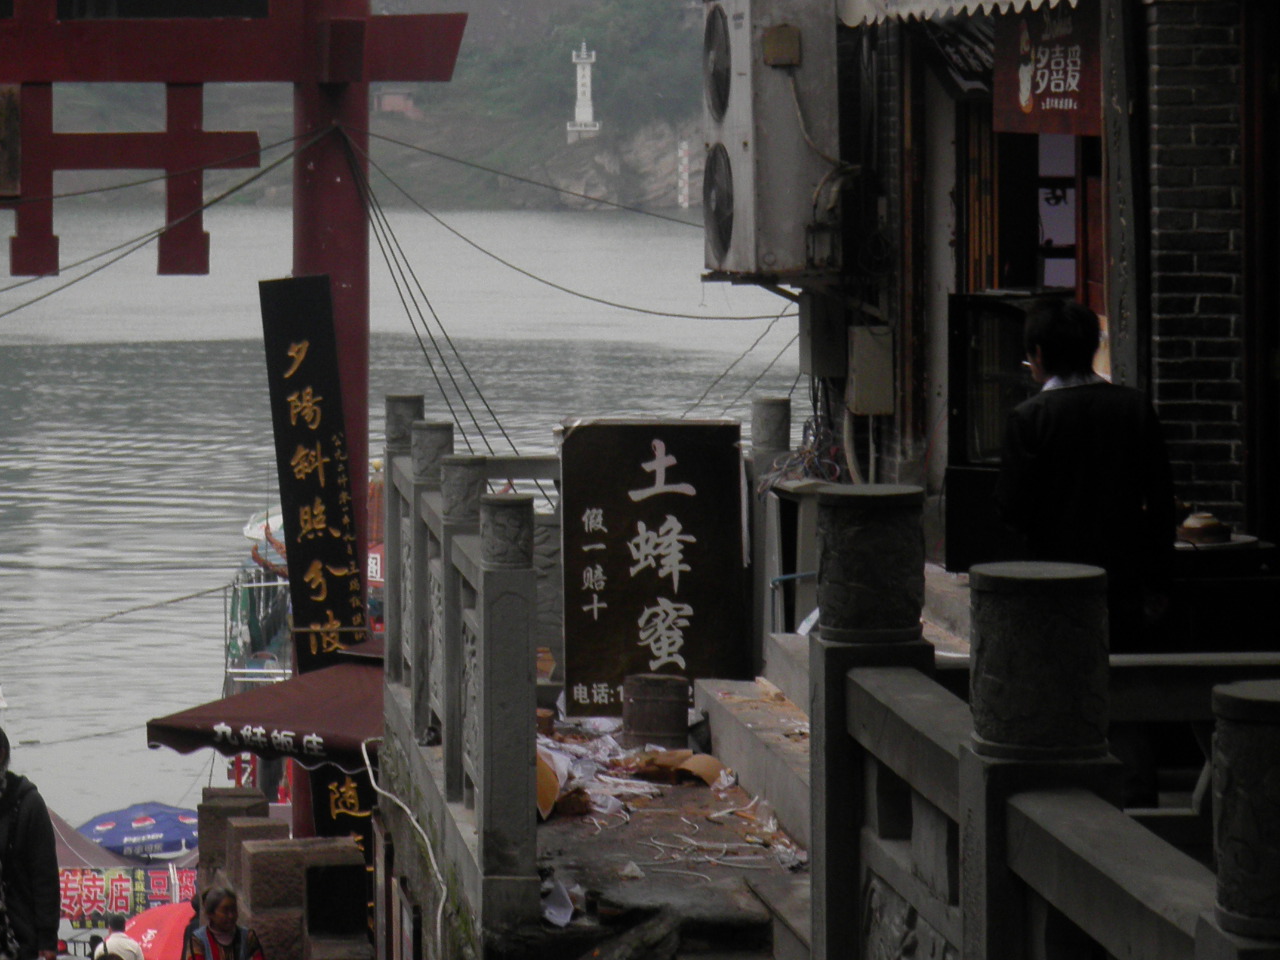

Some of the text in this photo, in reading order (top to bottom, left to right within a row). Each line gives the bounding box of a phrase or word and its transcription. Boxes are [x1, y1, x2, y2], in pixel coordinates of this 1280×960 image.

[581, 507, 608, 622] 假一赔十
[627, 438, 697, 672] 土蜂蜜
